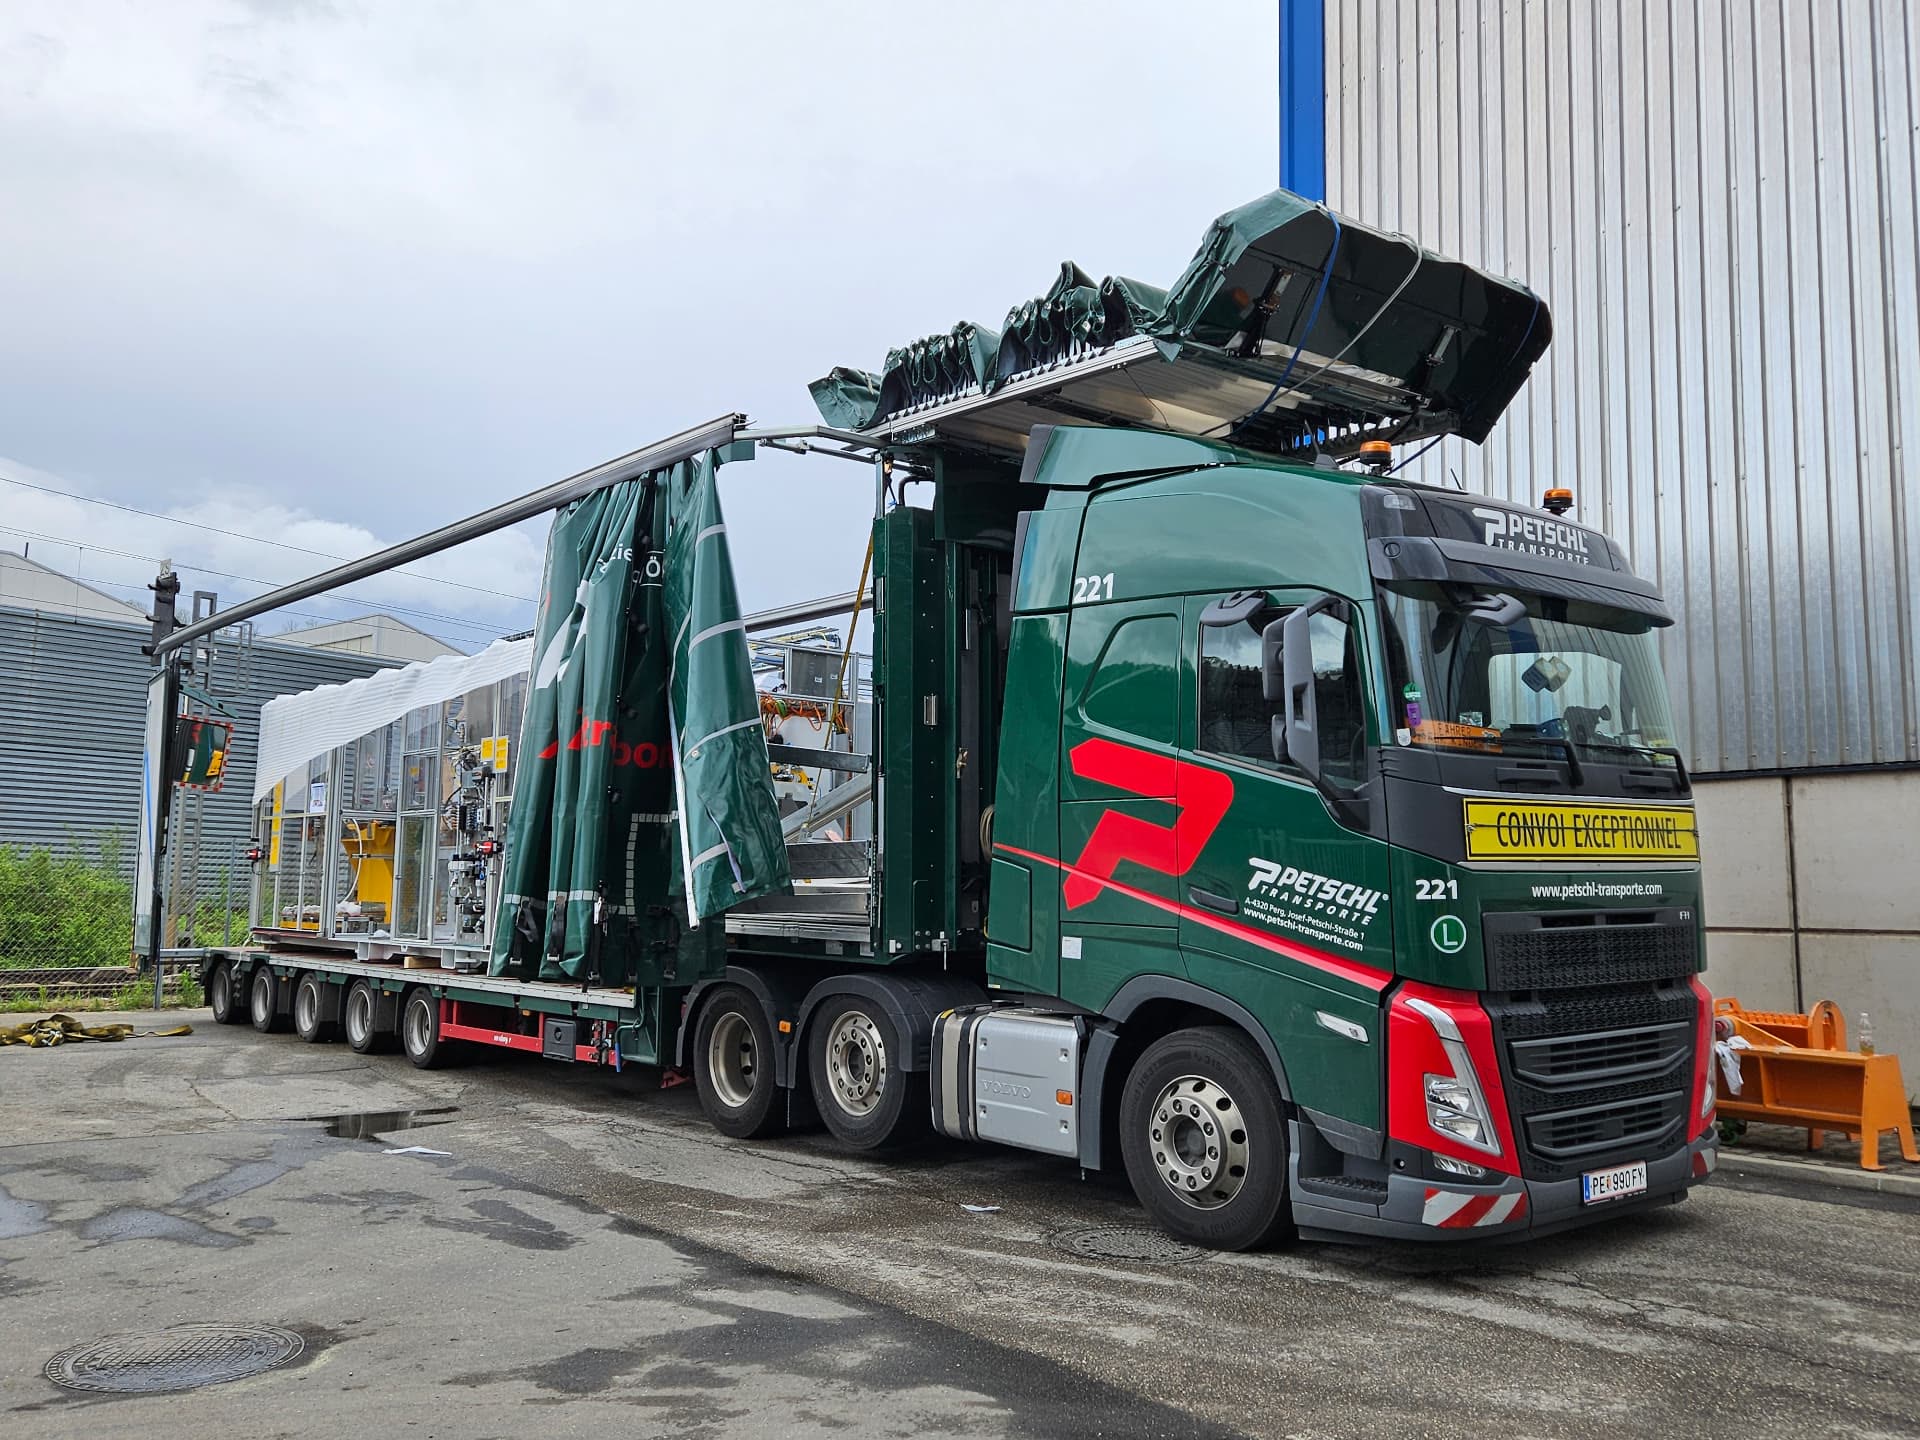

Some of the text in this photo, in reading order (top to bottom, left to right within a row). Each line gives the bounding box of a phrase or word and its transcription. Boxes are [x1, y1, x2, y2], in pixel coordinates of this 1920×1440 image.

[1498, 538, 1590, 567] TRANSPORTE
[1072, 572, 1115, 605] 221
[1496, 811, 1682, 849] CONVOI EXCEPTIONNEL
[1244, 896, 1269, 911] A-4320
[1415, 879, 1458, 900] 221
[1531, 882, 1663, 901] www.petschl-transporte.com
[1260, 885, 1373, 926] TRANSPORTE
[1243, 907, 1364, 951] www.petschl-transporte.com
[981, 1079, 1032, 1099] VOLVO
